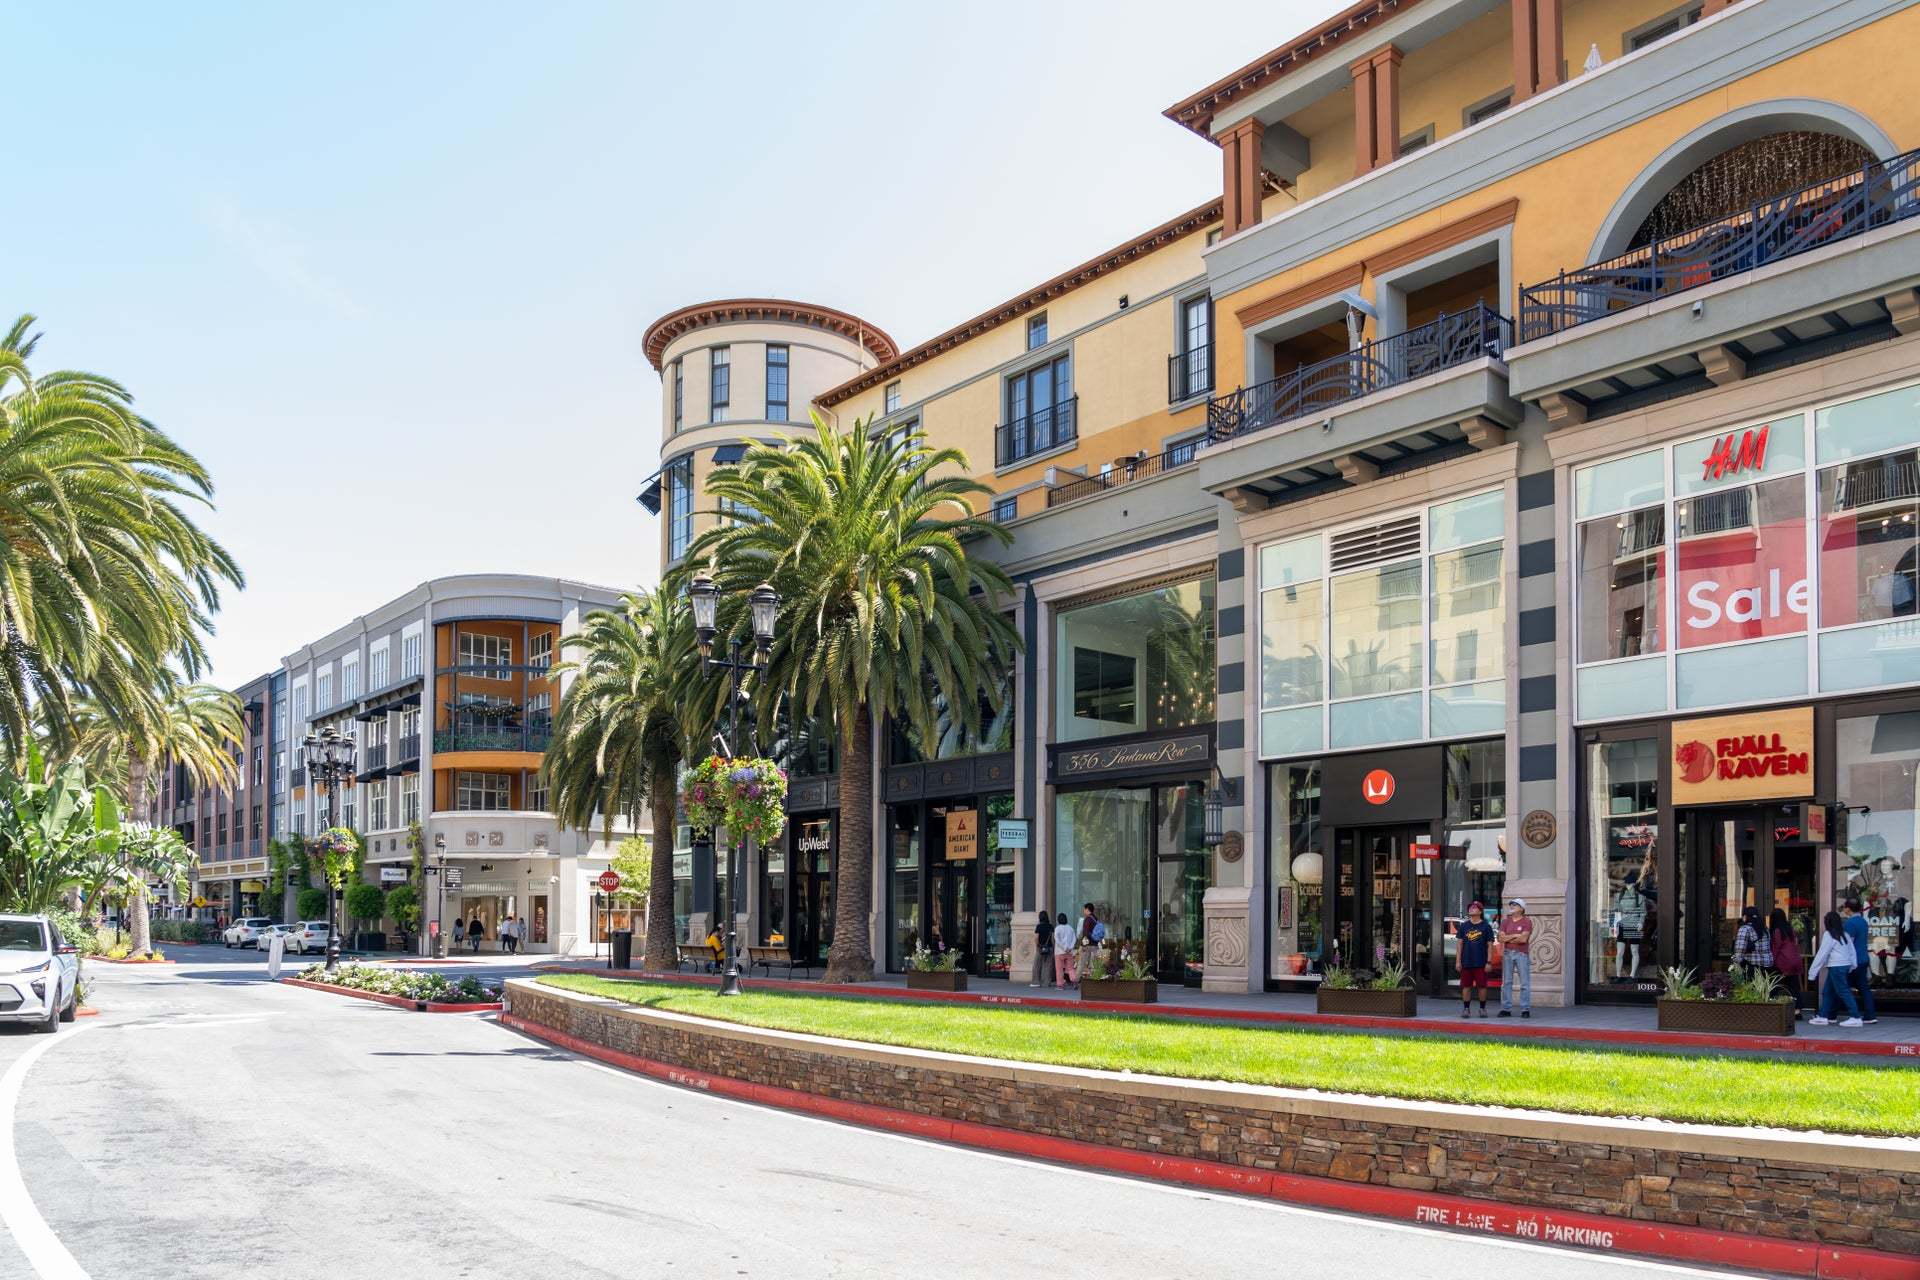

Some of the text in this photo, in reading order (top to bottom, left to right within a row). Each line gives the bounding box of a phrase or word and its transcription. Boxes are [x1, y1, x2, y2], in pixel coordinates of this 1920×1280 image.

[1701, 424, 1770, 481] H&M
[1686, 567, 1809, 629] Sale
[1101, 745, 1158, 768] Santana
[1155, 741, 1202, 762] Row
[798, 837, 829, 851] UpWest
[948, 833, 976, 843] AMERICAN
[953, 845, 969, 853] GIANT
[600, 877, 619, 886] STOP
[1894, 1045, 1915, 1055] FIRE
[1416, 1206, 1450, 1224] FIRE
[1455, 1212, 1495, 1231] LANE
[1516, 1219, 1539, 1237] NO
[1545, 1223, 1613, 1248] PARKING
